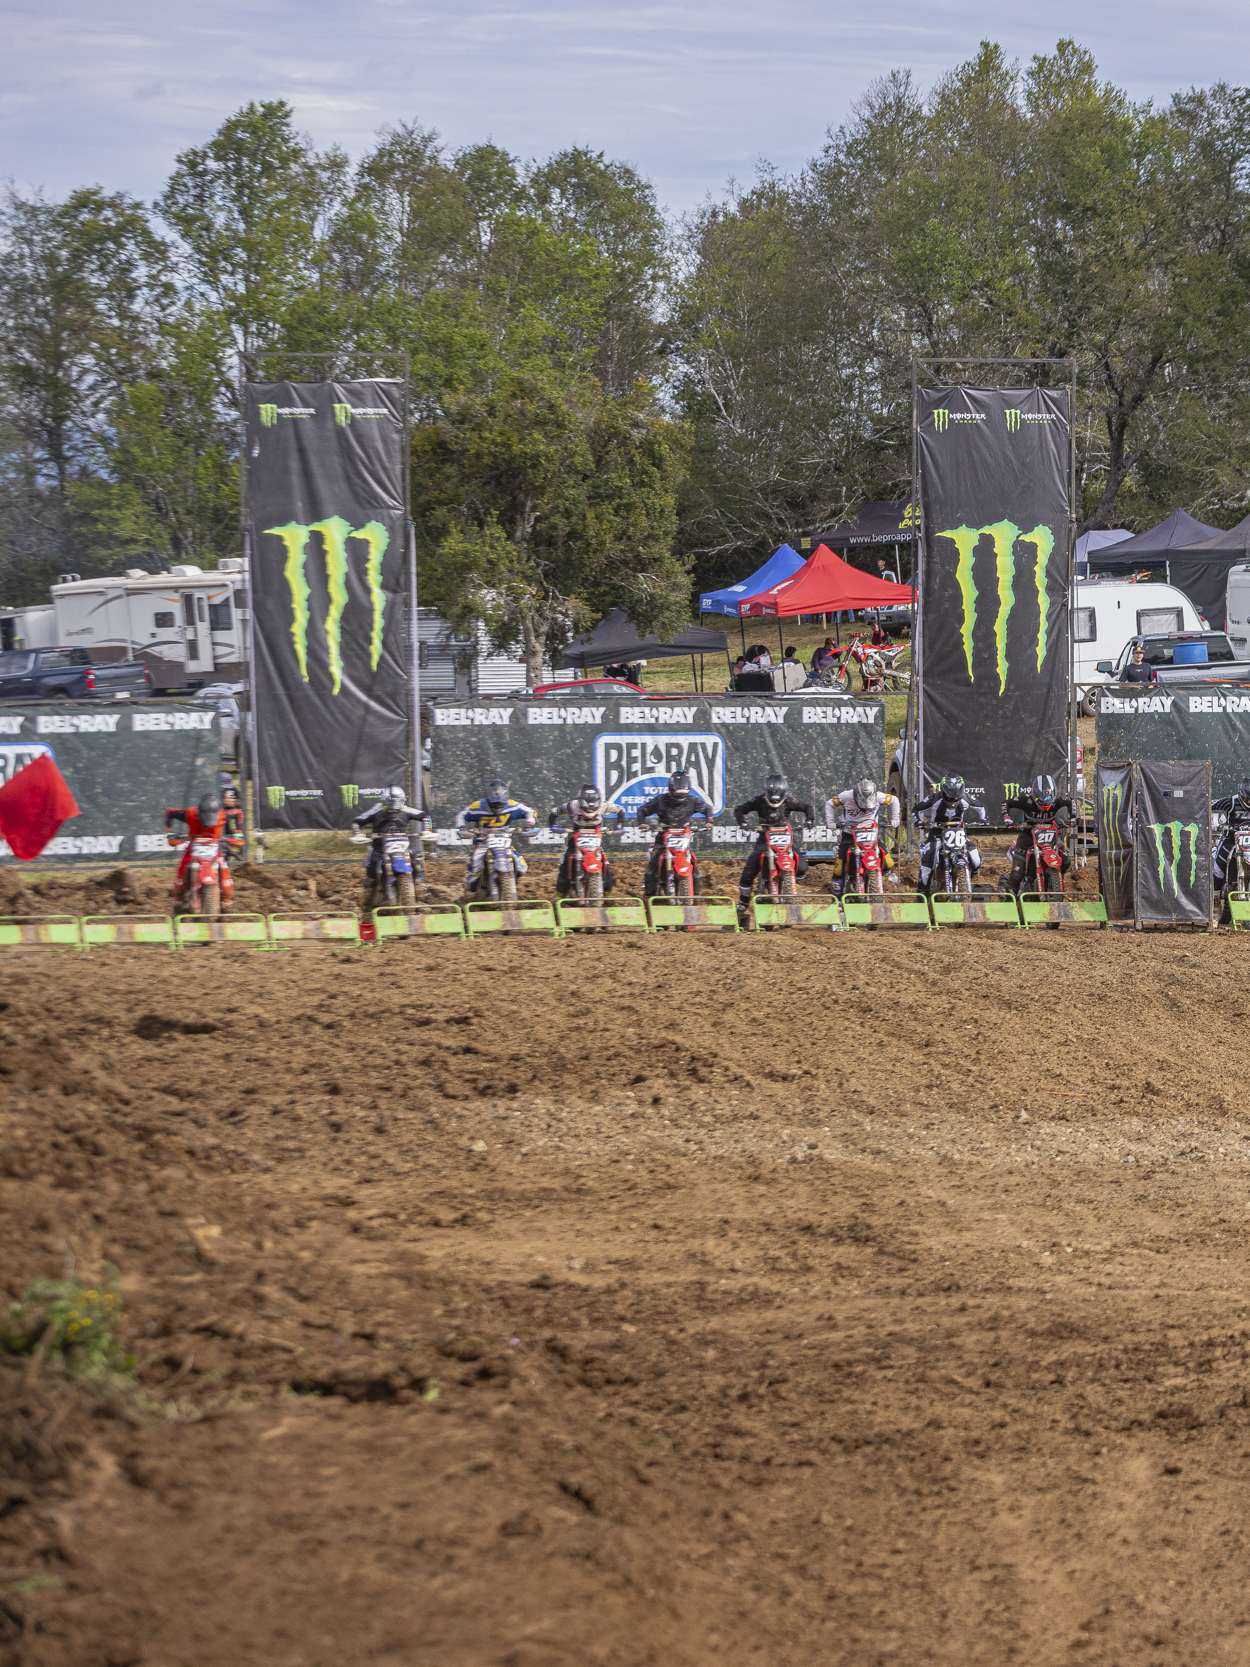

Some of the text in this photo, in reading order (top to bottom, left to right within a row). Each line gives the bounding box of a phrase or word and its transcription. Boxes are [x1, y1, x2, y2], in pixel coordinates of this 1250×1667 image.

[949, 412, 986, 420] MONSTER
[1021, 412, 1056, 420] MONSTER
[643, 786, 669, 795] TOTA
[478, 813, 512, 828] FLY
[944, 830, 966, 847] 26
[1038, 832, 1056, 843] 217
